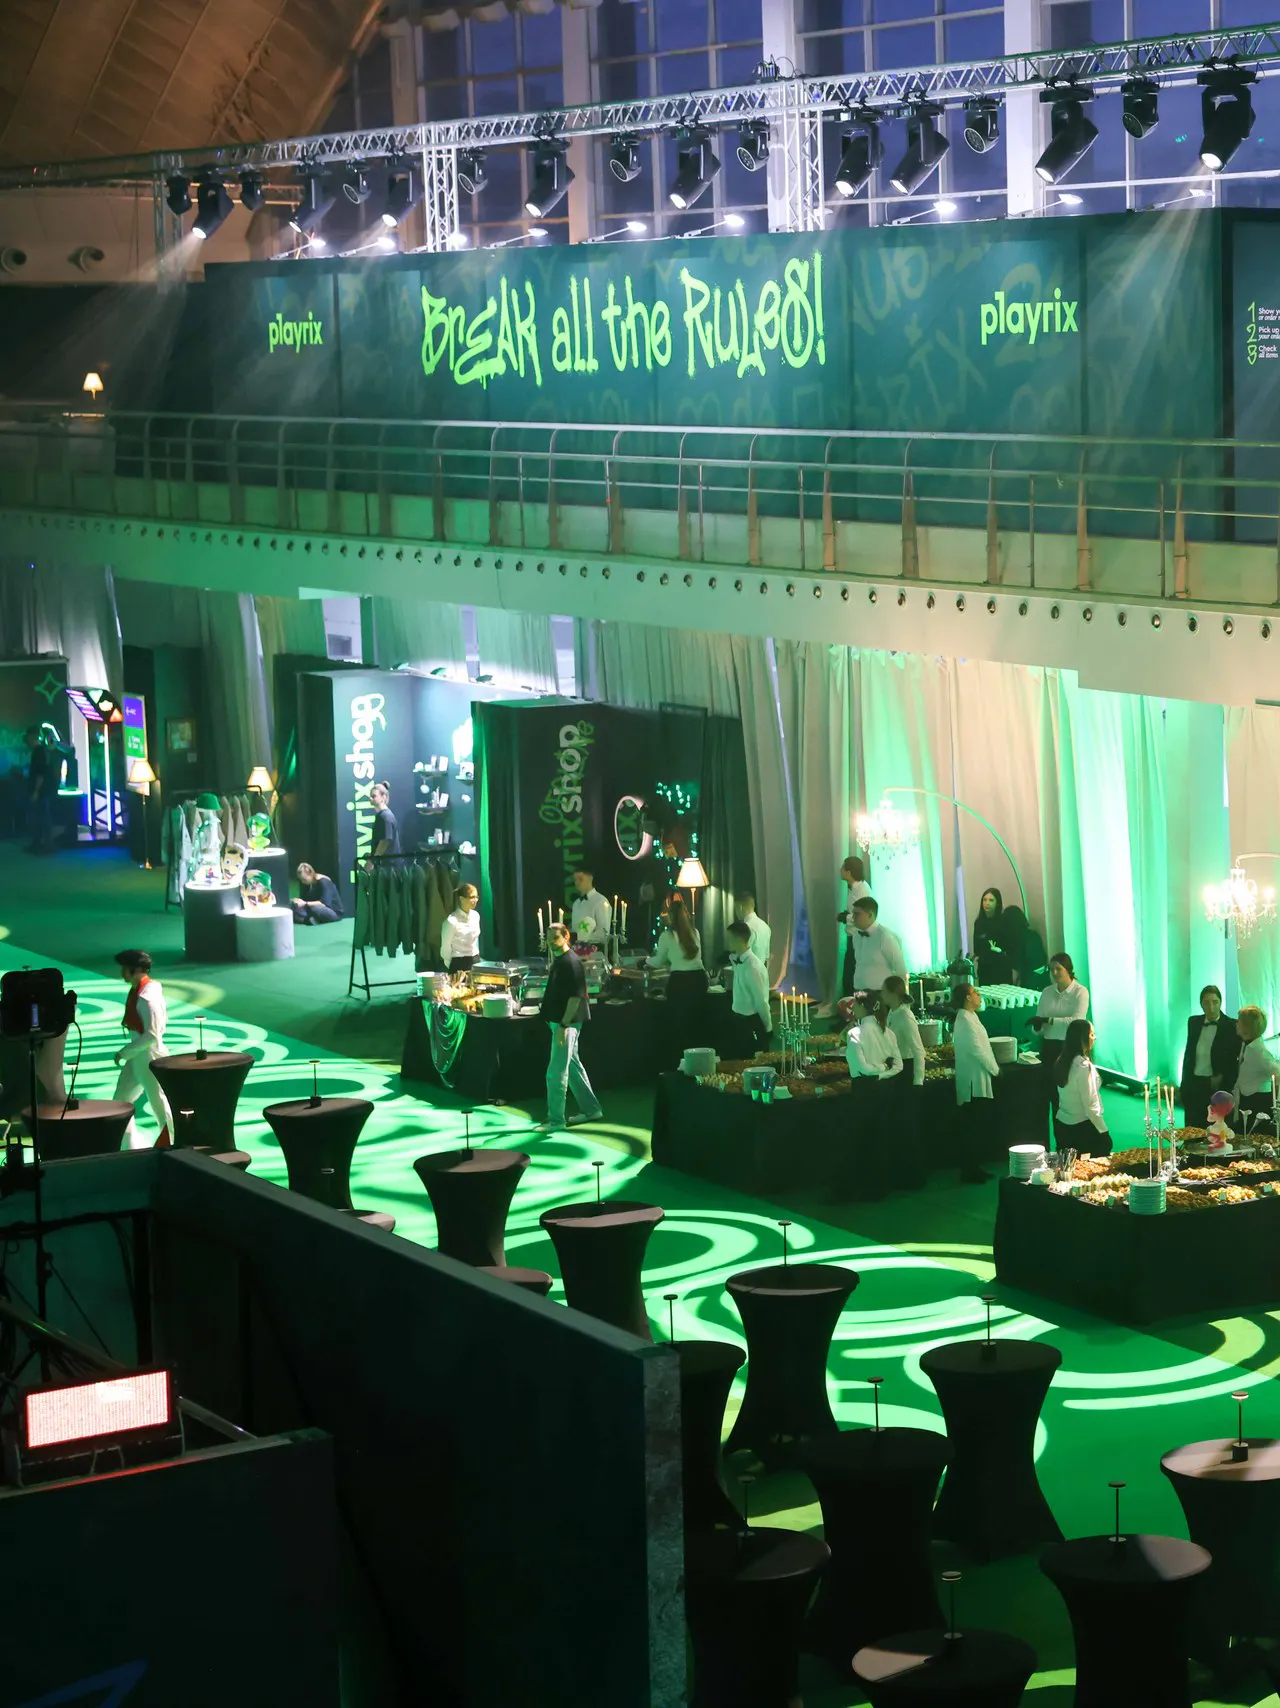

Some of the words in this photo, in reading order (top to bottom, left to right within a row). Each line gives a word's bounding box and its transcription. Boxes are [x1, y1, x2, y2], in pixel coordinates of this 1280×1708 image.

[552, 274, 599, 375] all
[981, 288, 1079, 345] playrix
[1247, 301, 1256, 323] 1
[269, 309, 324, 353] playrix
[1246, 324, 1257, 343] 2
[1247, 345, 1257, 365] 3
